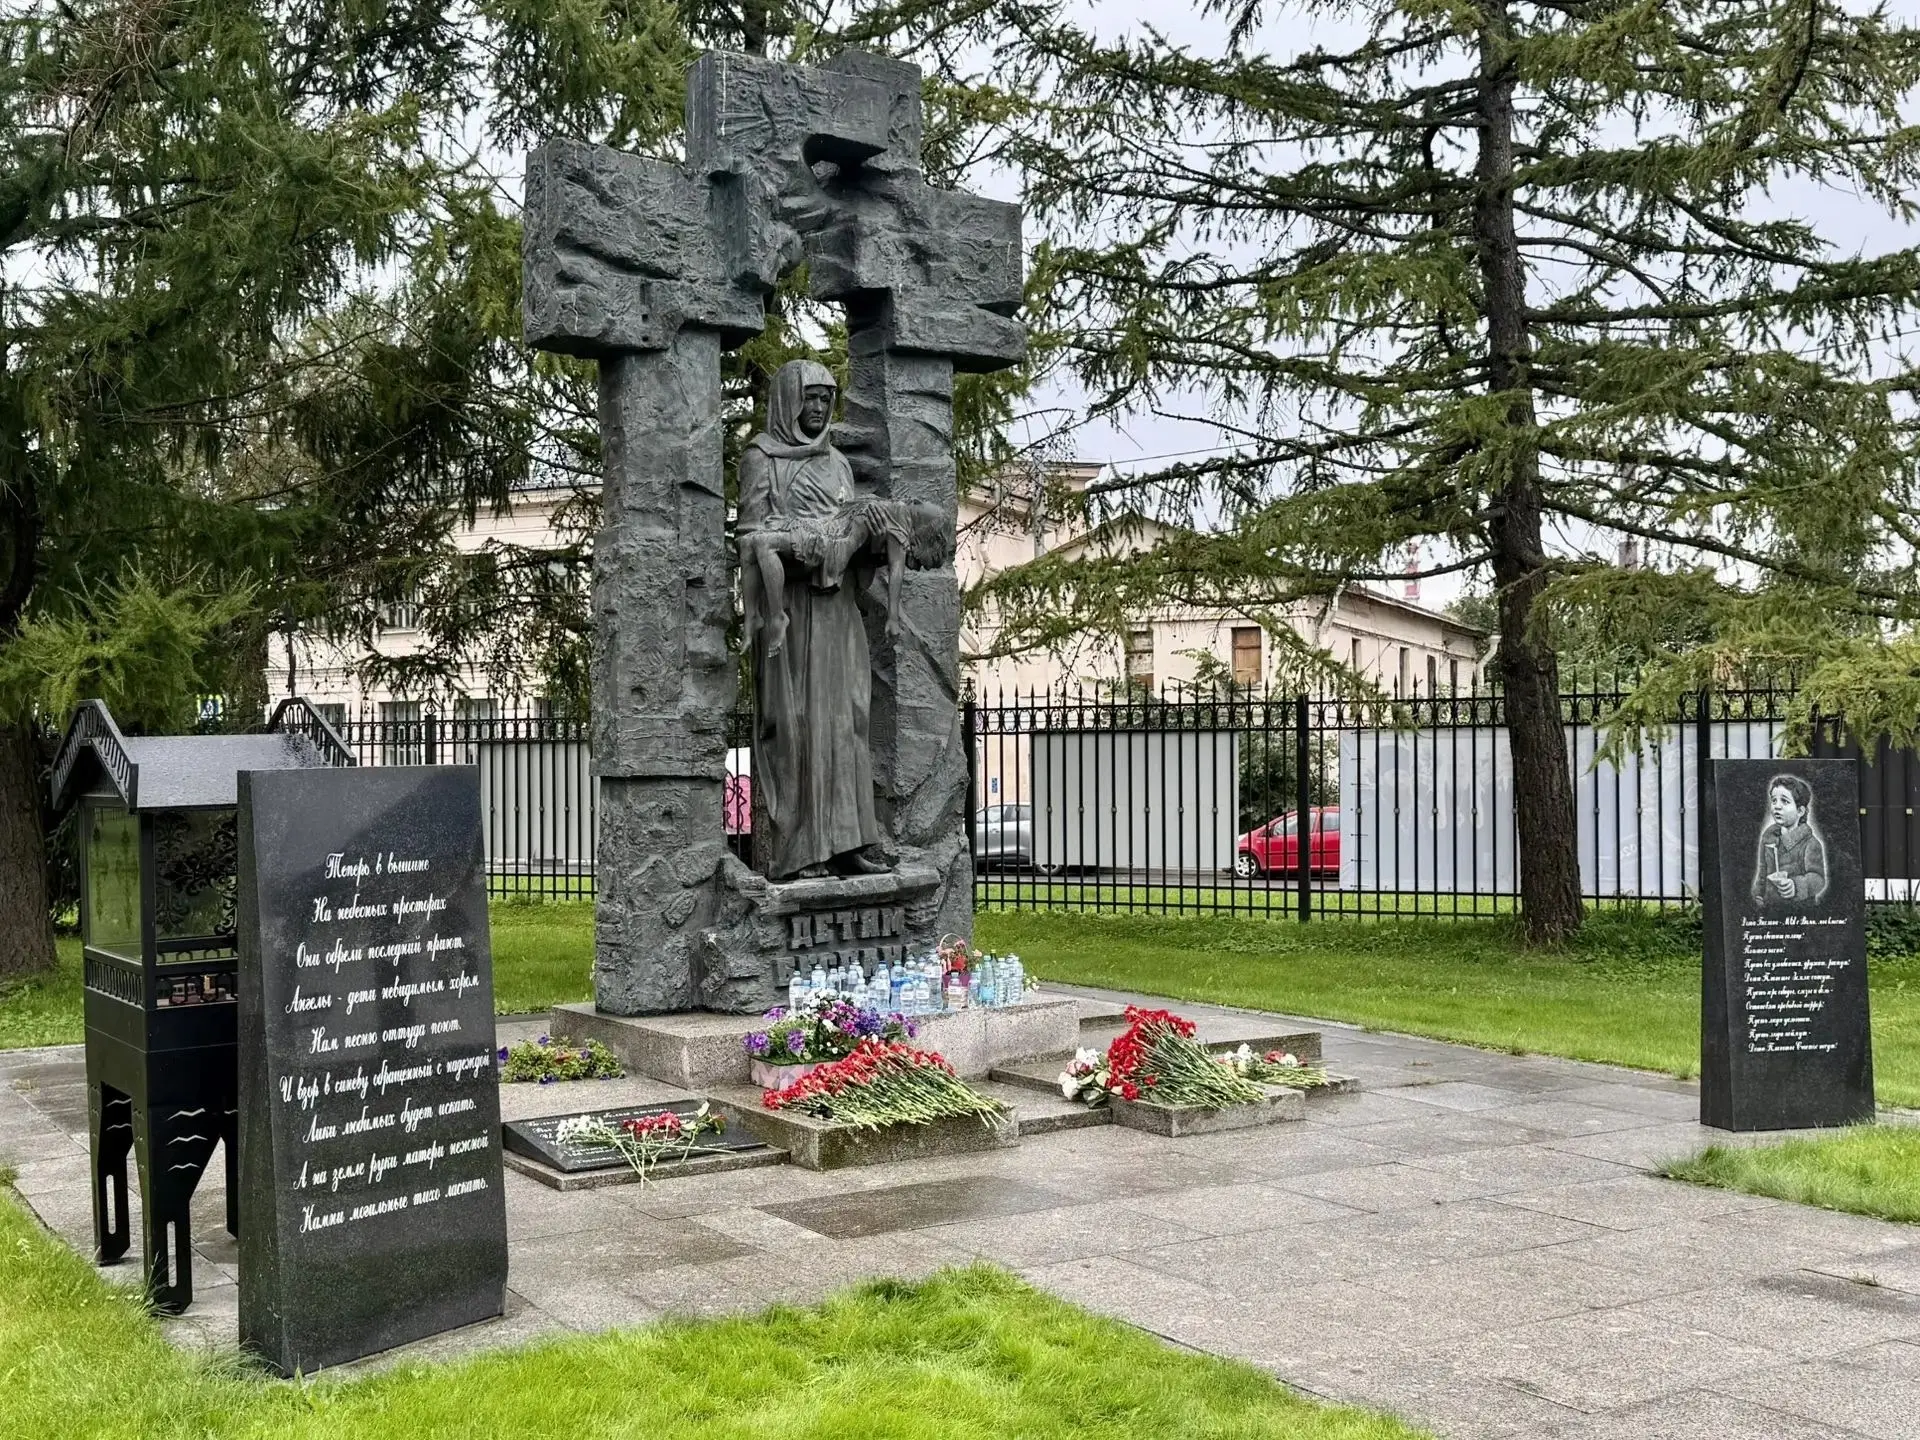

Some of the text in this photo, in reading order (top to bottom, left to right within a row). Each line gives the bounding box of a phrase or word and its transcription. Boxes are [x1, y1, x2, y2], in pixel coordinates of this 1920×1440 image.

[324, 852, 430, 887] Теперь в вышине
[311, 893, 447, 925] На небесных просторах
[791, 907, 904, 949] ДЕТЯМ
[296, 933, 465, 974] Они обрели последний приют.
[772, 945, 922, 988] БЕСЛАН
[285, 985, 332, 1014] Ангелы
[346, 986, 377, 1016] дети
[381, 975, 445, 1007] невидимым
[449, 969, 480, 999] хором
[309, 1018, 462, 1054] Нам песню оттуда поют.
[279, 1076, 293, 1103] И
[297, 1076, 319, 1110] взор
[324, 1071, 330, 1096] в
[334, 1066, 368, 1099] синеву
[436, 1062, 442, 1075] с
[446, 1048, 490, 1081] надеждой
[302, 1097, 477, 1143] Лики любимых будет искать.
[293, 1129, 489, 1192] А на земле руки матери нежной
[299, 1177, 489, 1233] Камни могильные тихо ласкать.
